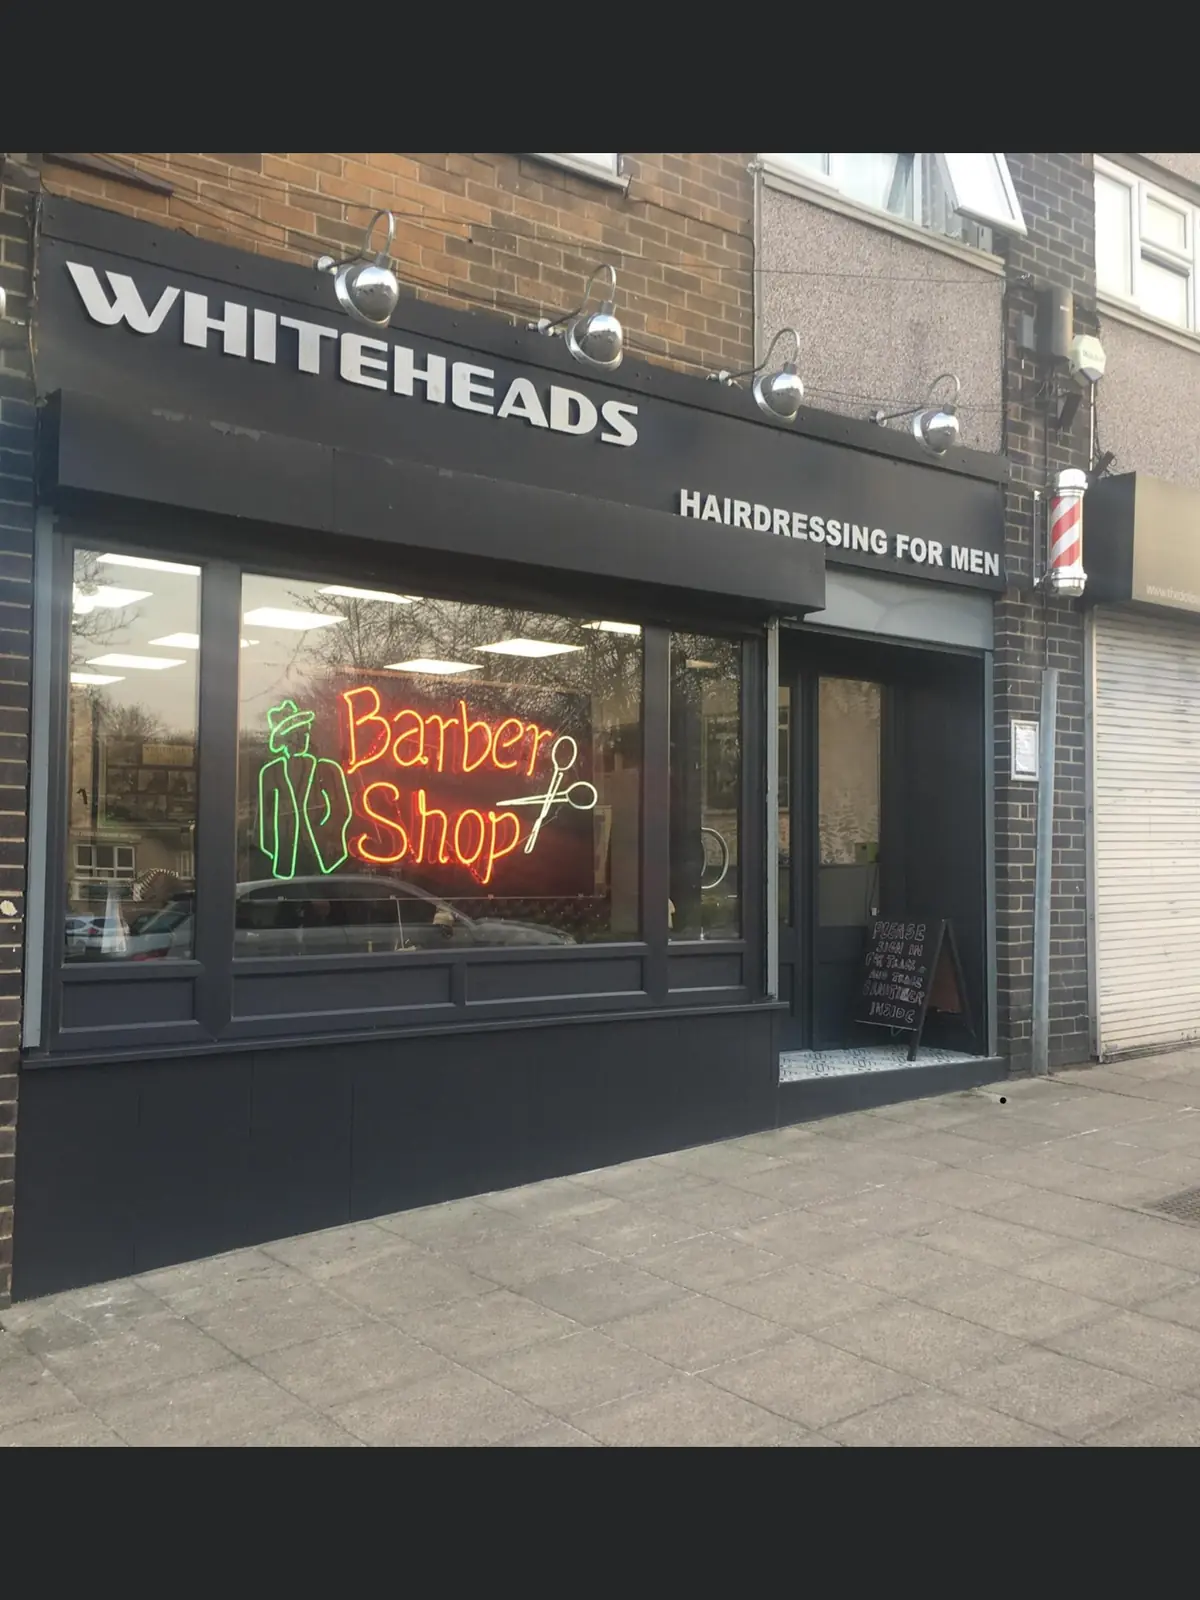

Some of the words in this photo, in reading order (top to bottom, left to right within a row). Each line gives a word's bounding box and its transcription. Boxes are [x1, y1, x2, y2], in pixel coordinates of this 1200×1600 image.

[66, 261, 638, 447] WHITEHEADS
[680, 488, 887, 555] HAIRDRESSING
[896, 533, 943, 567] FOR
[951, 545, 1000, 576] MEN
[342, 686, 552, 776] Barber
[358, 781, 520, 884] Shop
[872, 921, 926, 941] PLEASE
[876, 941, 904, 954] SIGN
